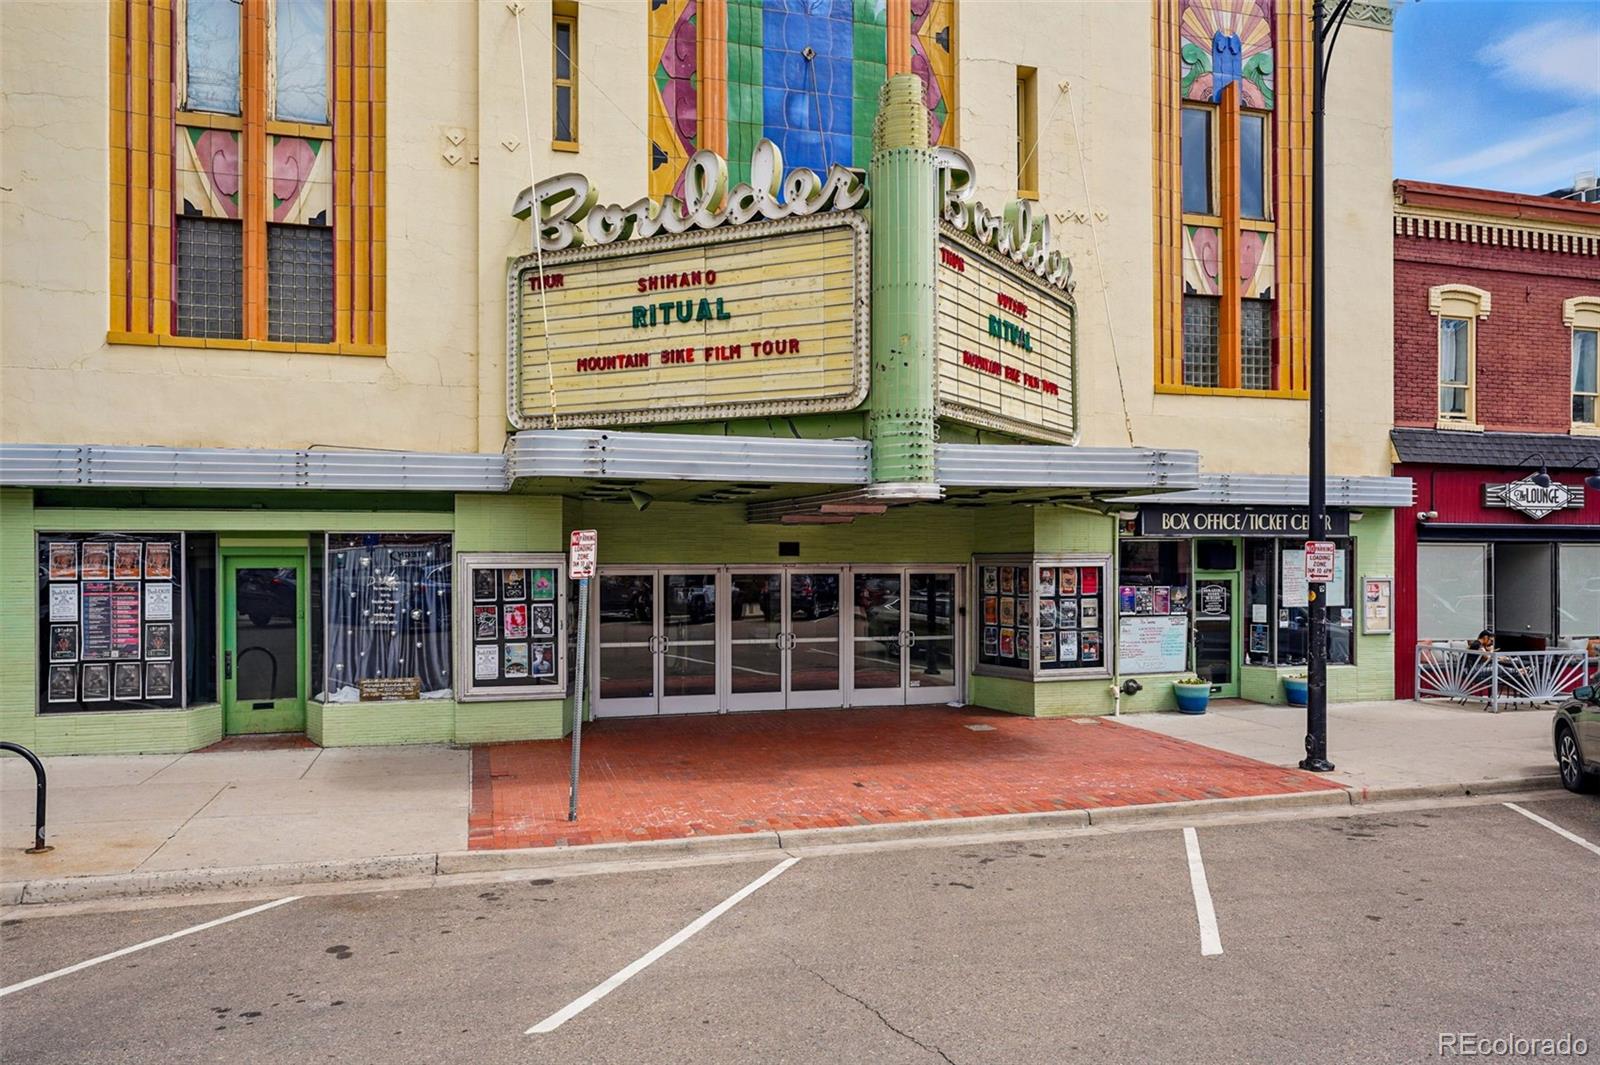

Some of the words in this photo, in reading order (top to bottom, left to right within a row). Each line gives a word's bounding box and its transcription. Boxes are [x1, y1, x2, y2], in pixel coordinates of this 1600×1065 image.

[511, 138, 869, 250] Boulder
[528, 273, 564, 291] TOUR
[637, 269, 717, 293] SHIMANO
[632, 297, 732, 328] RITUAL
[989, 314, 1033, 353] RITUAL
[576, 352, 649, 372] MOUNTAIN
[661, 347, 695, 365] BIKE
[704, 344, 742, 362] FILM
[751, 338, 800, 357] TOUR
[1525, 488, 1559, 504] LOUNGE
[1162, 513, 1191, 530] BOX
[1290, 514, 1332, 530] CER
[575, 544, 593, 552] LOADING
